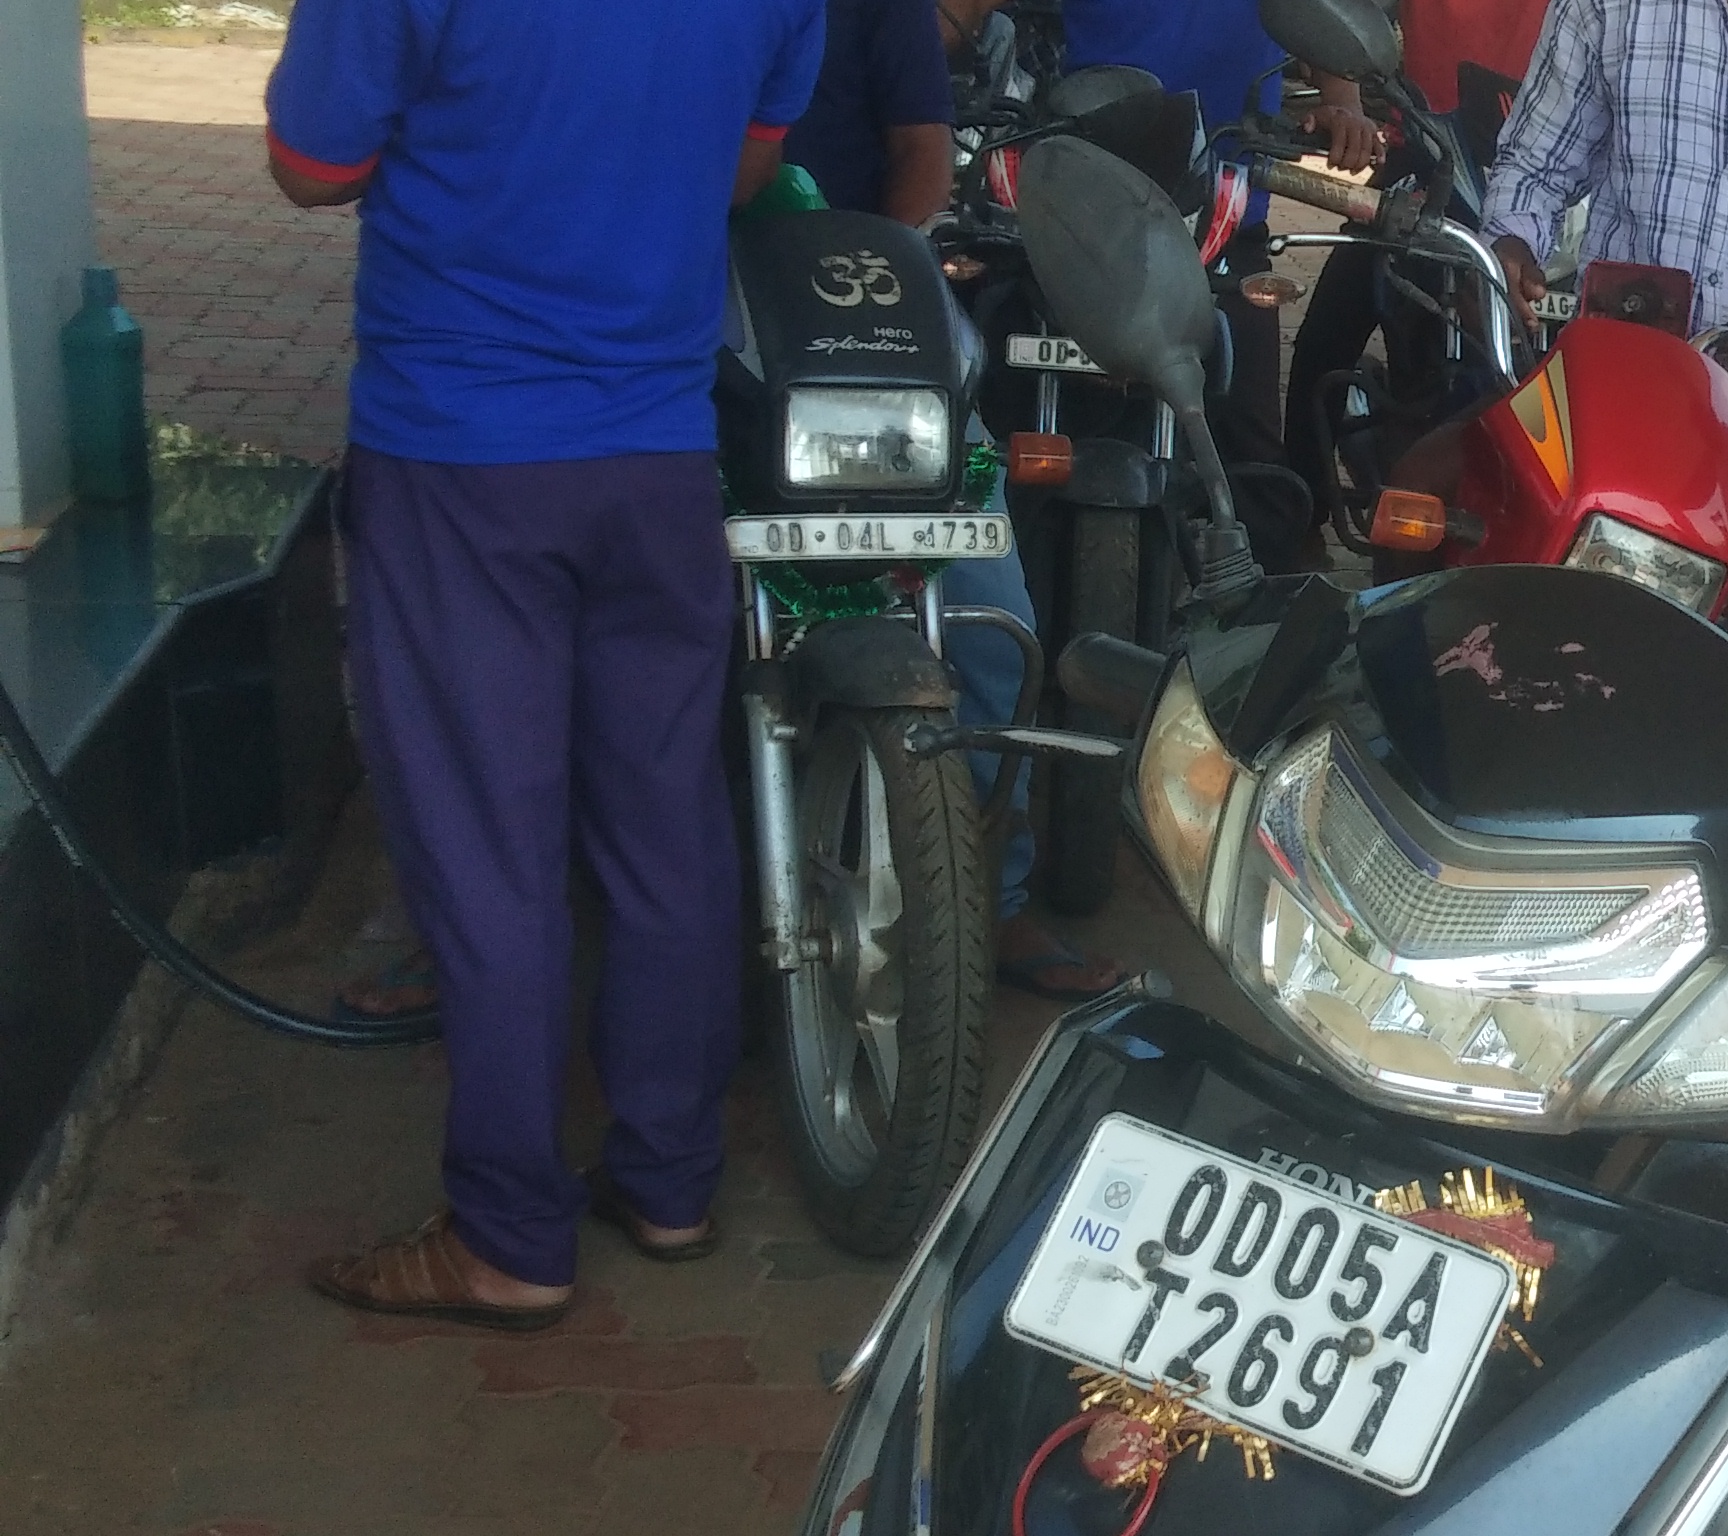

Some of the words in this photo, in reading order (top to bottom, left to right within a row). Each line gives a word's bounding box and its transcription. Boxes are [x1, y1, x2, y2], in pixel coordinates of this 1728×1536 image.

[873, 327, 913, 340] Hero
[1069, 1215, 1121, 1252] IND
[1164, 1164, 1448, 1354] OD05A
[1122, 1267, 1408, 1457] T2691
